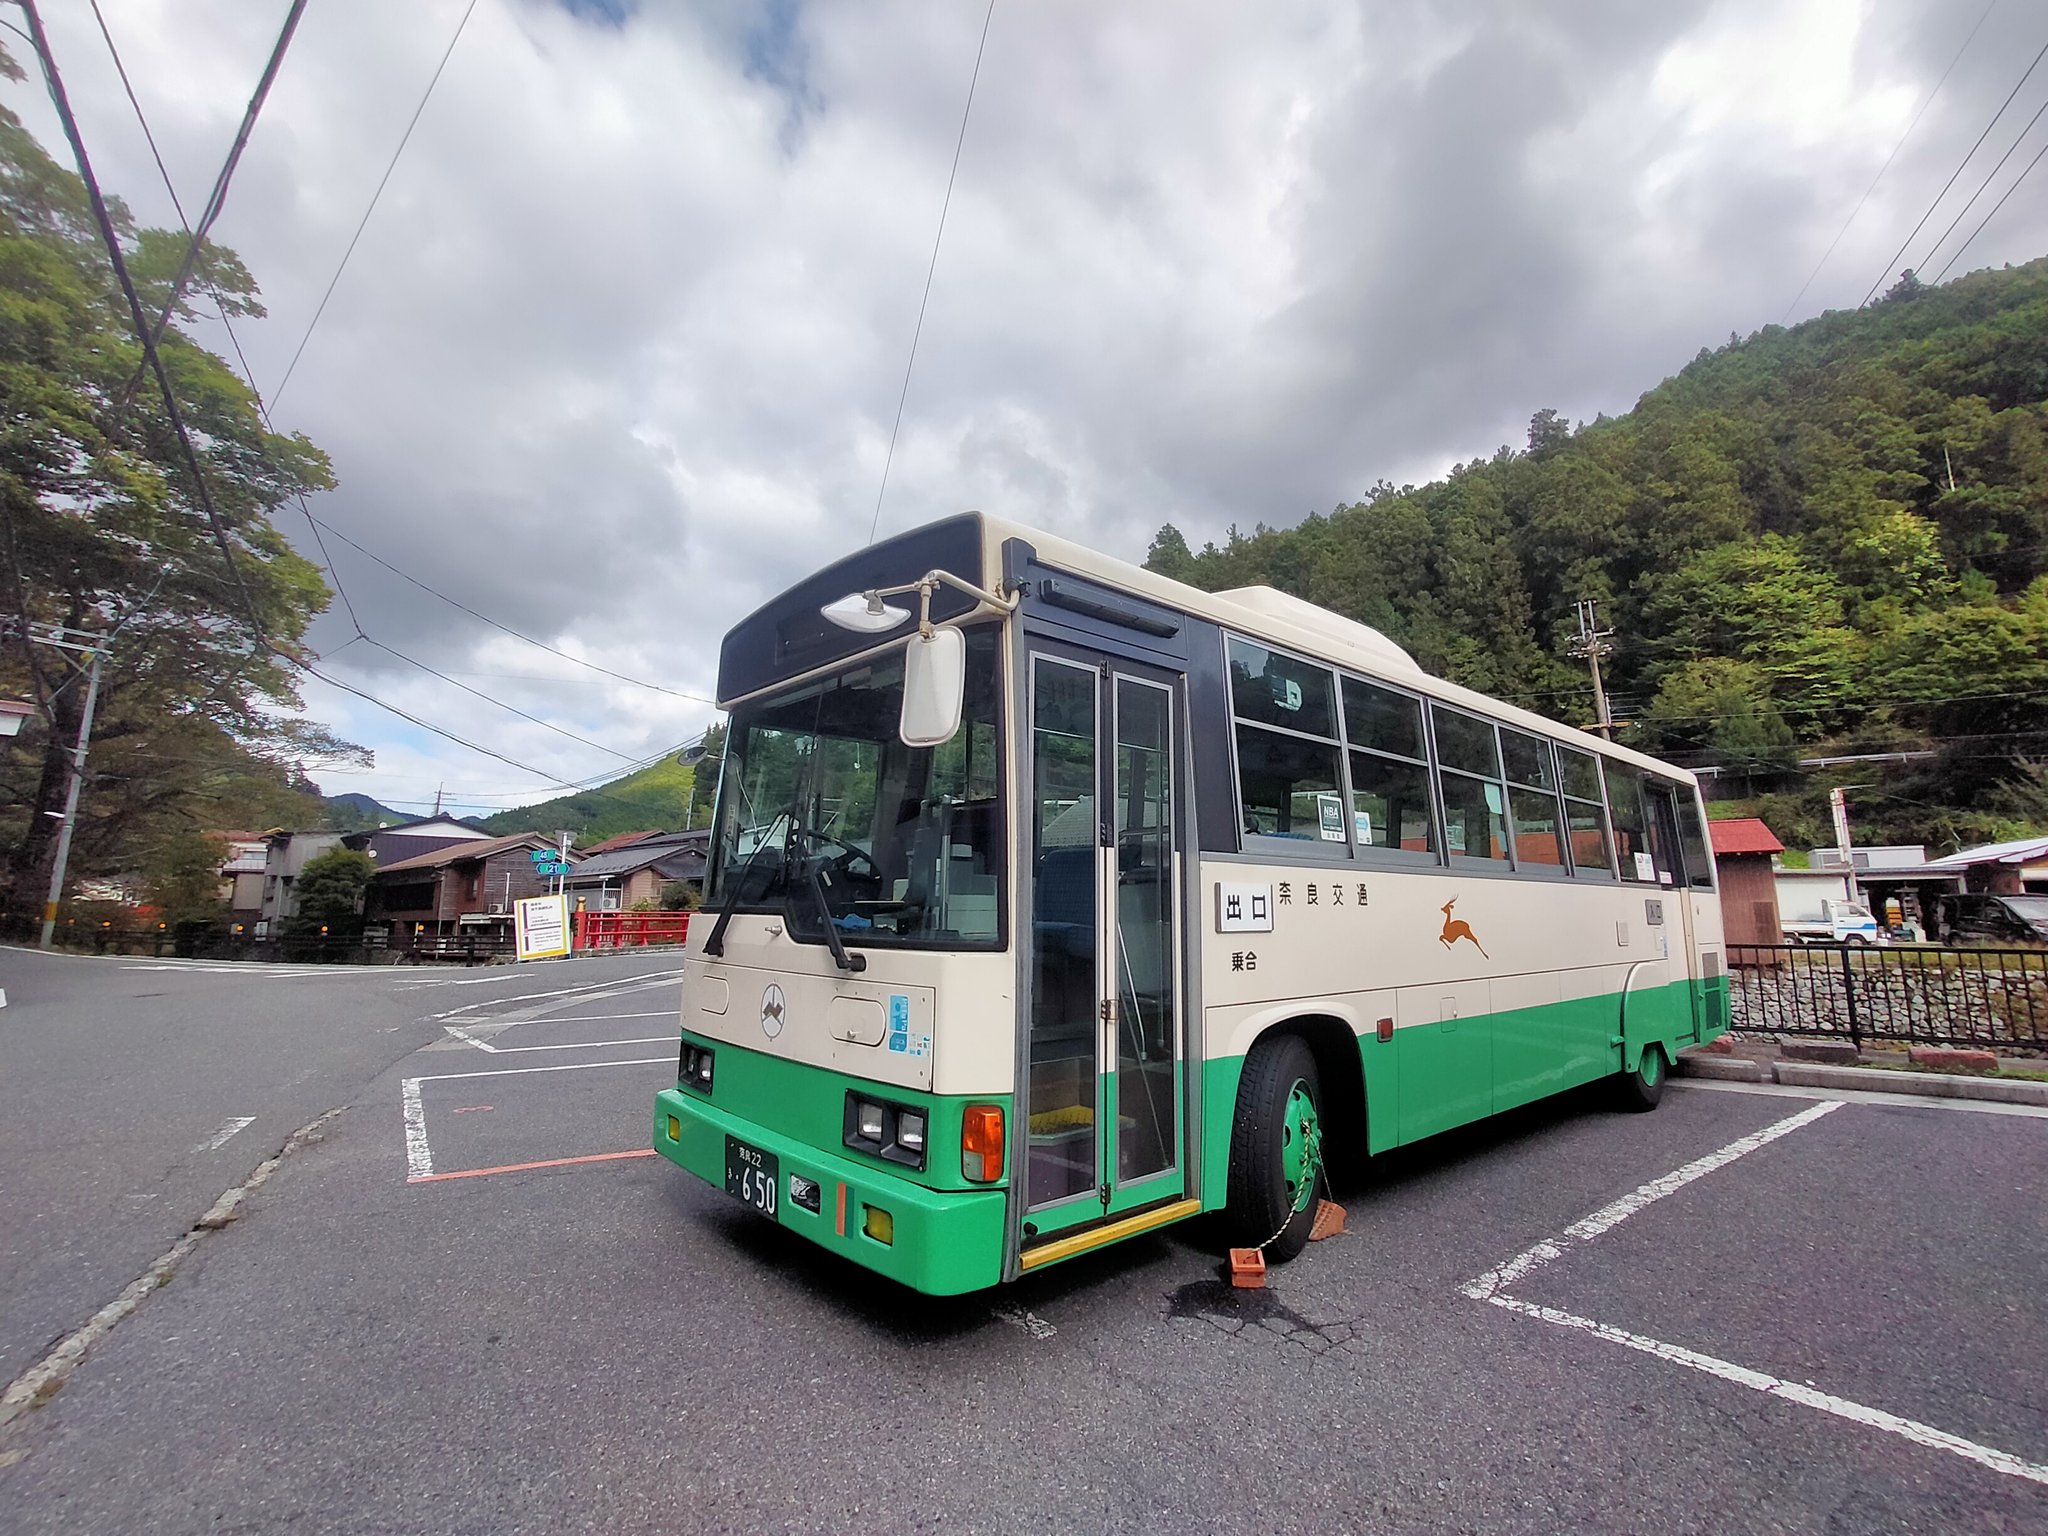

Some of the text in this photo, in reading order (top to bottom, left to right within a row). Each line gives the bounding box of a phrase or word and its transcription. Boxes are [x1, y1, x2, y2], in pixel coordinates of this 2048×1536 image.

[548, 865, 558, 873] 21
[1278, 881, 1369, 907] 奈良交通
[1226, 894, 1267, 921] 出口
[1649, 903, 1662, 919] 入口
[1231, 951, 1258, 972] 乗合
